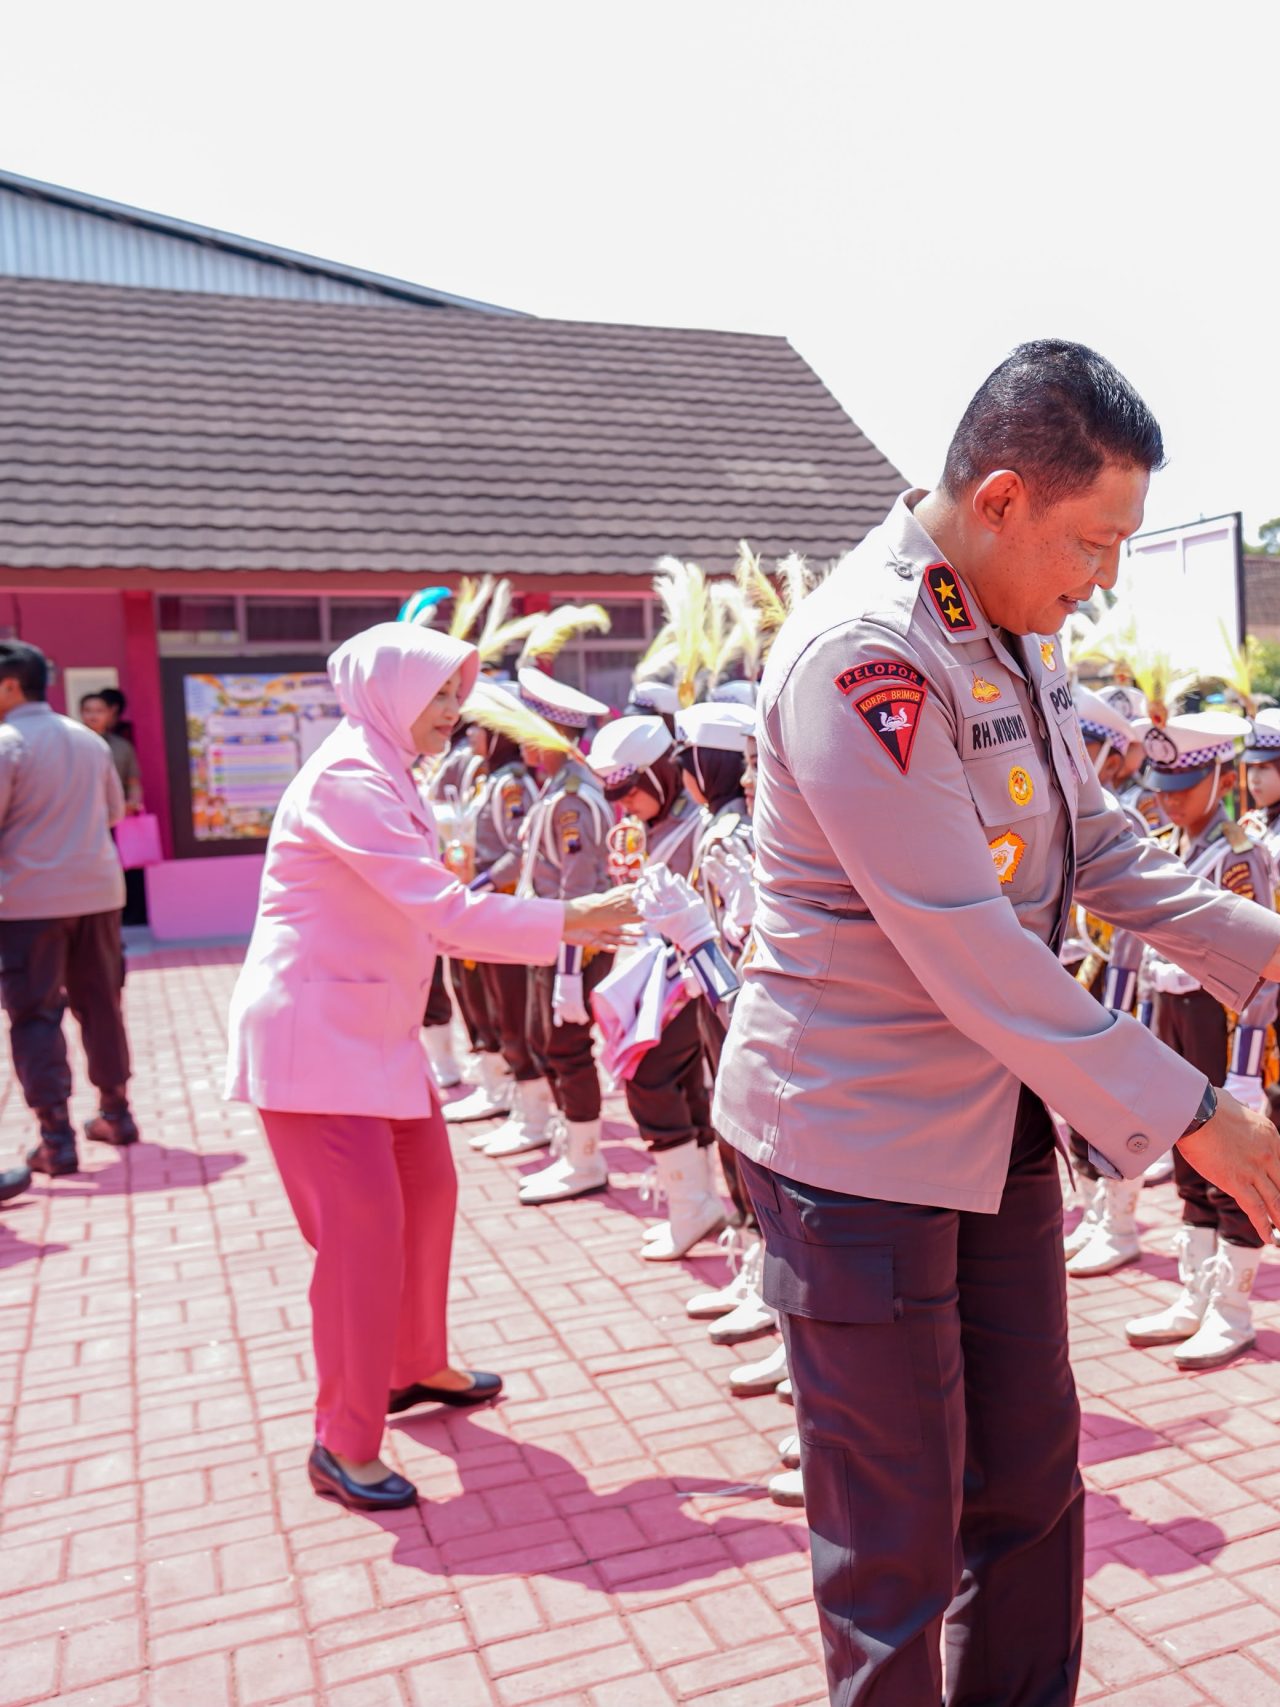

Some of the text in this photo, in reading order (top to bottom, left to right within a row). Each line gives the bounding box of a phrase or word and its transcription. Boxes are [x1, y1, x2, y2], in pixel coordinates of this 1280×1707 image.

[843, 663, 918, 686] PELOPOR
[859, 689, 921, 712] KORPS BRIMOB
[1049, 681, 1074, 716] POL
